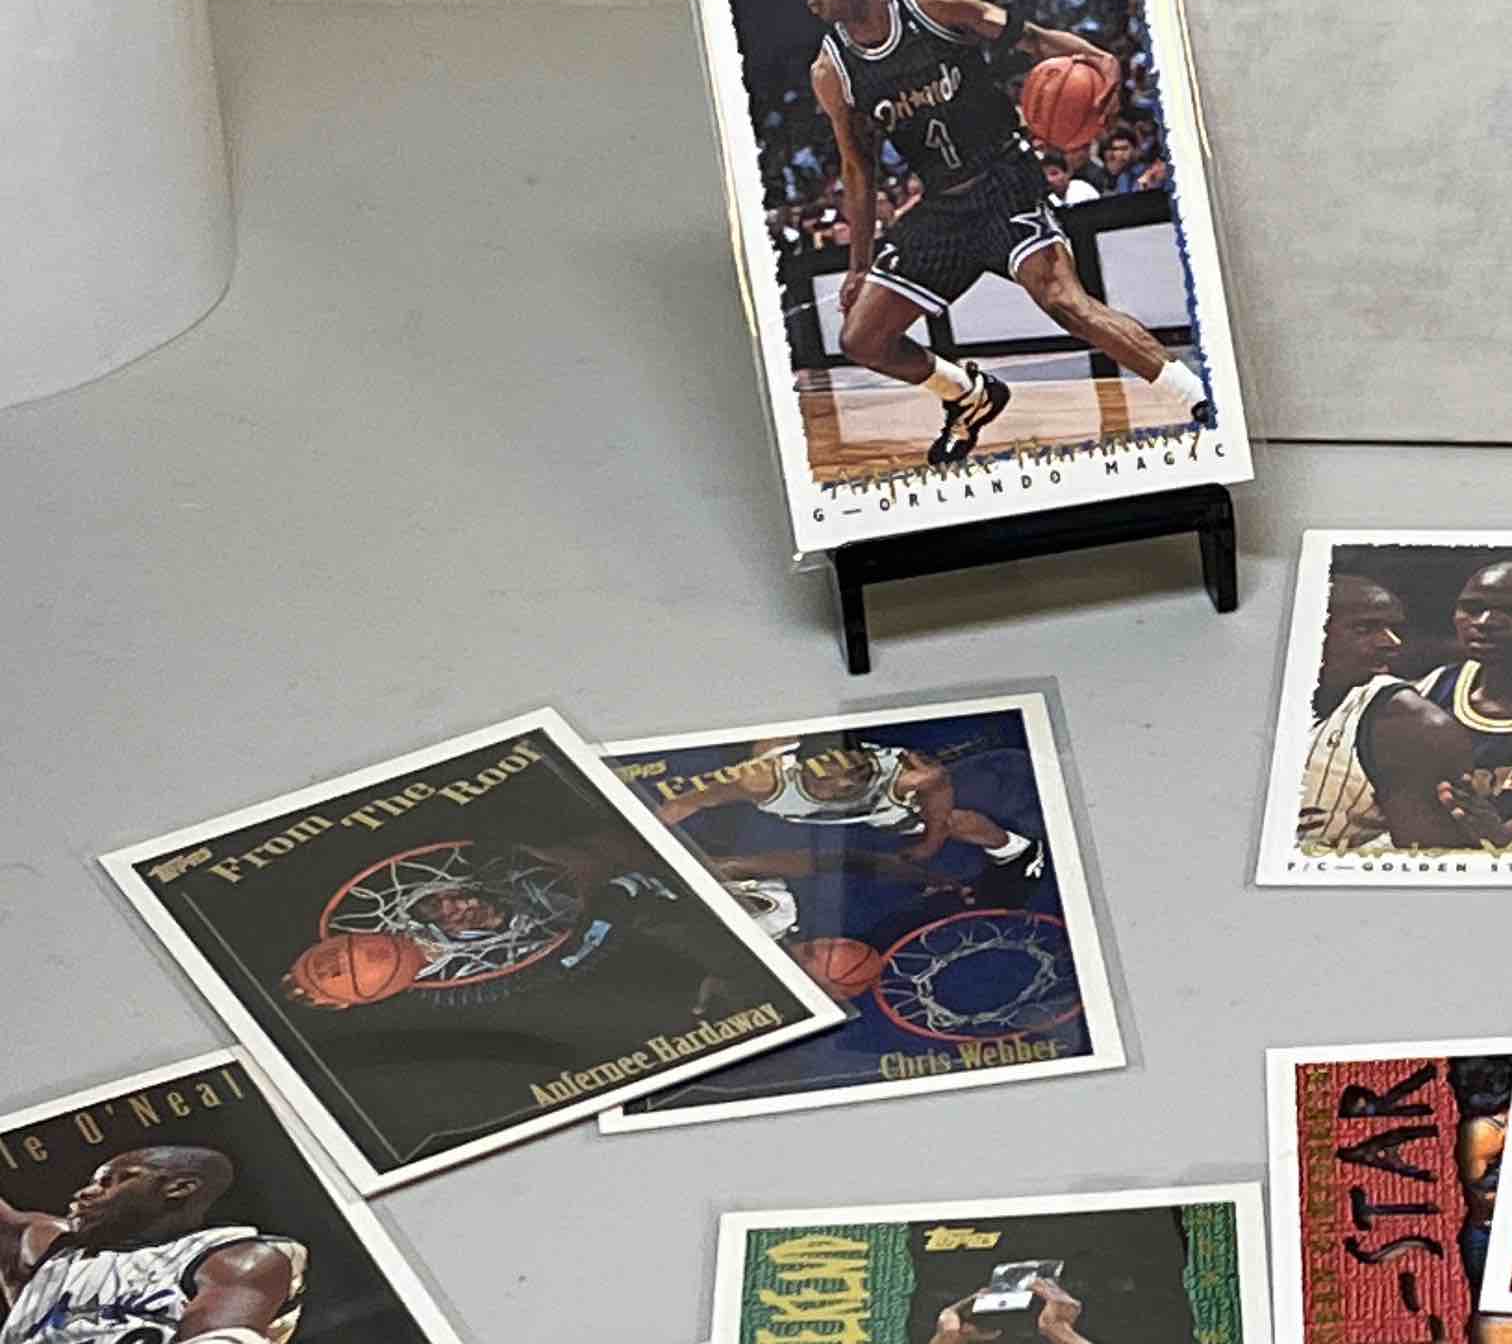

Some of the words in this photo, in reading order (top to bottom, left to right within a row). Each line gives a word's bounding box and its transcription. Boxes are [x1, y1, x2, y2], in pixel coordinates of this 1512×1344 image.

[207, 811, 336, 885] From
[340, 778, 437, 834] The
[436, 739, 544, 808] Roof
[528, 1043, 648, 1108] Anfernee
[648, 1000, 784, 1060] Hardaway
[878, 1051, 950, 1082] Chris
[955, 1039, 1062, 1074] Webber
[75, 1069, 245, 1145] O'Neal
